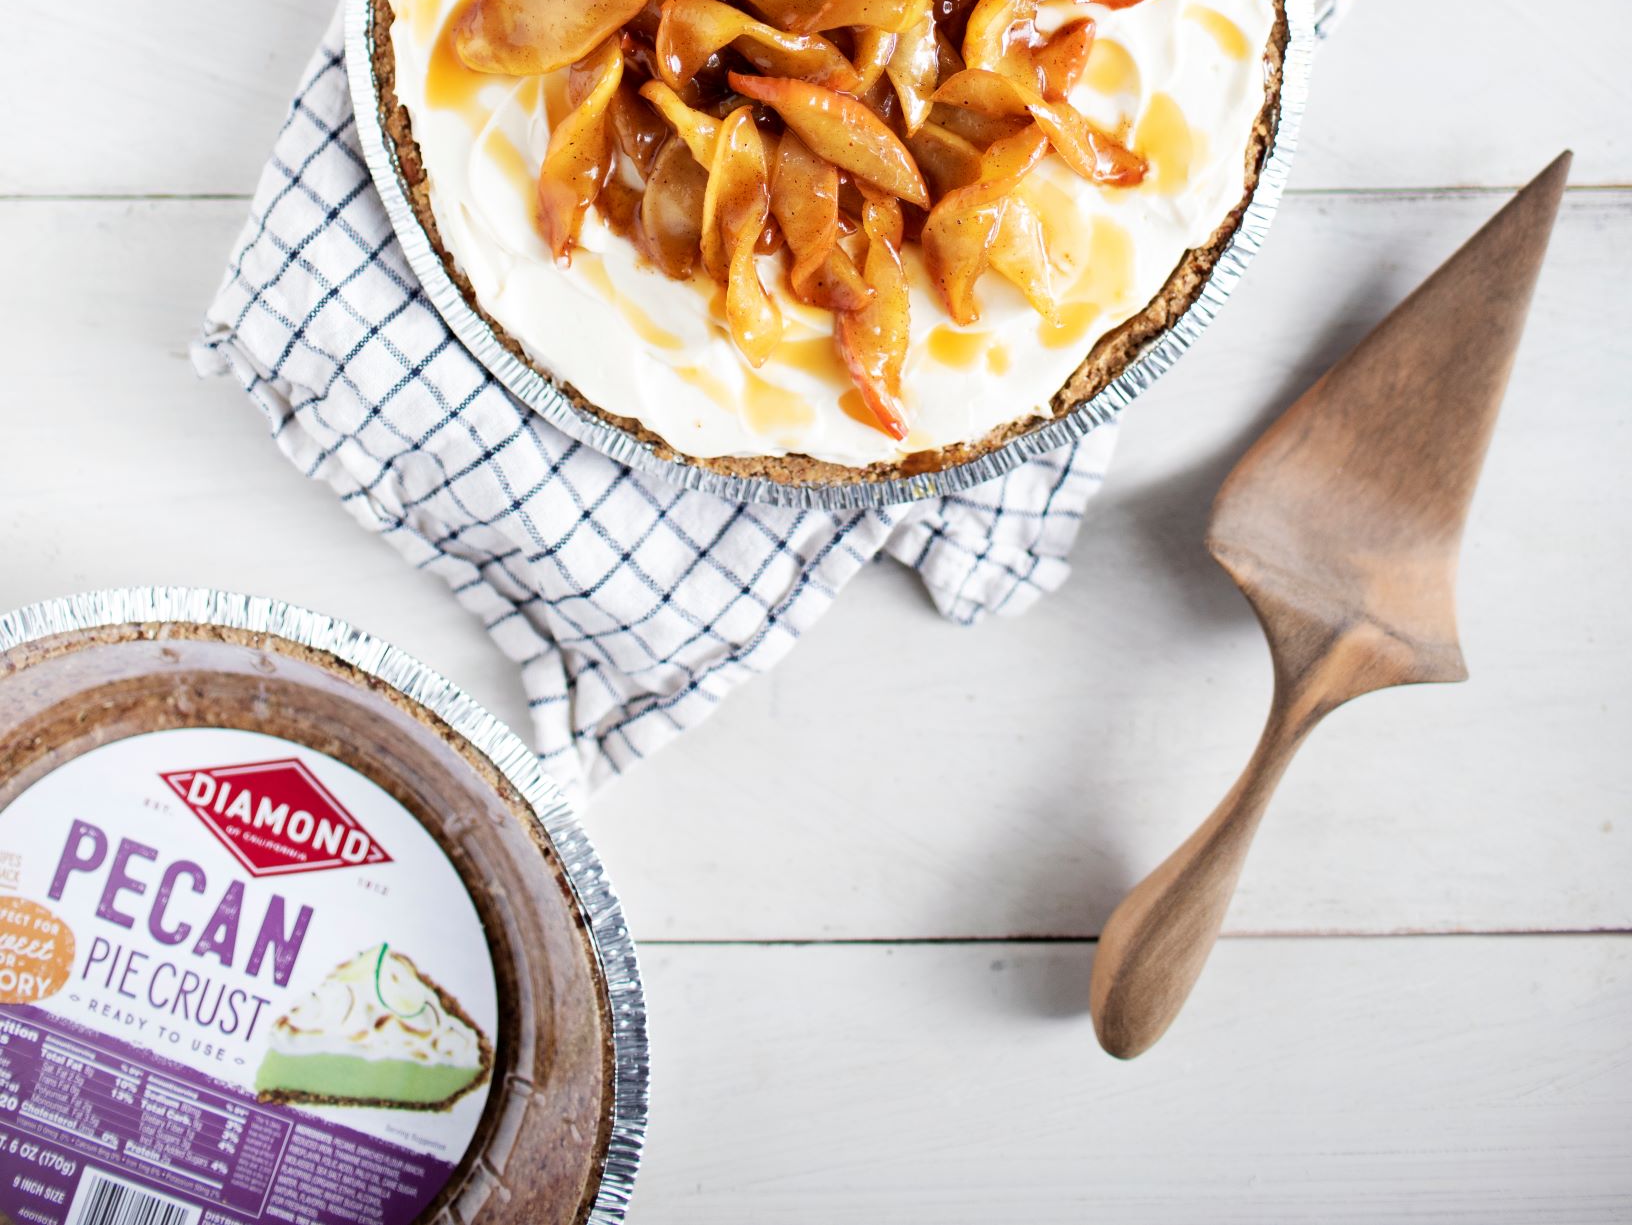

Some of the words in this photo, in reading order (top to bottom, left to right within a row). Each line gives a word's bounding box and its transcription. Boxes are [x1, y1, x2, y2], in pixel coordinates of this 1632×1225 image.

[186, 771, 371, 863] DIAMOND
[47, 818, 314, 988] PECAN
[33, 918, 59, 936] FOR
[0, 967, 52, 1001] ORY
[82, 936, 149, 999] PIE
[148, 962, 271, 1042] CRUST
[88, 999, 148, 1030] READY
[158, 1026, 181, 1044] TO
[191, 1039, 226, 1062] USE
[21, 1101, 77, 1129] Cholesterol
[9, 1138, 19, 1154] 6
[20, 1142, 39, 1161] OZ
[39, 1150, 76, 1177] (170g)
[125, 1140, 161, 1161] Protein
[12, 1175, 21, 1188] 9
[21, 1177, 44, 1197] INCH
[43, 1185, 65, 1205] SIZE
